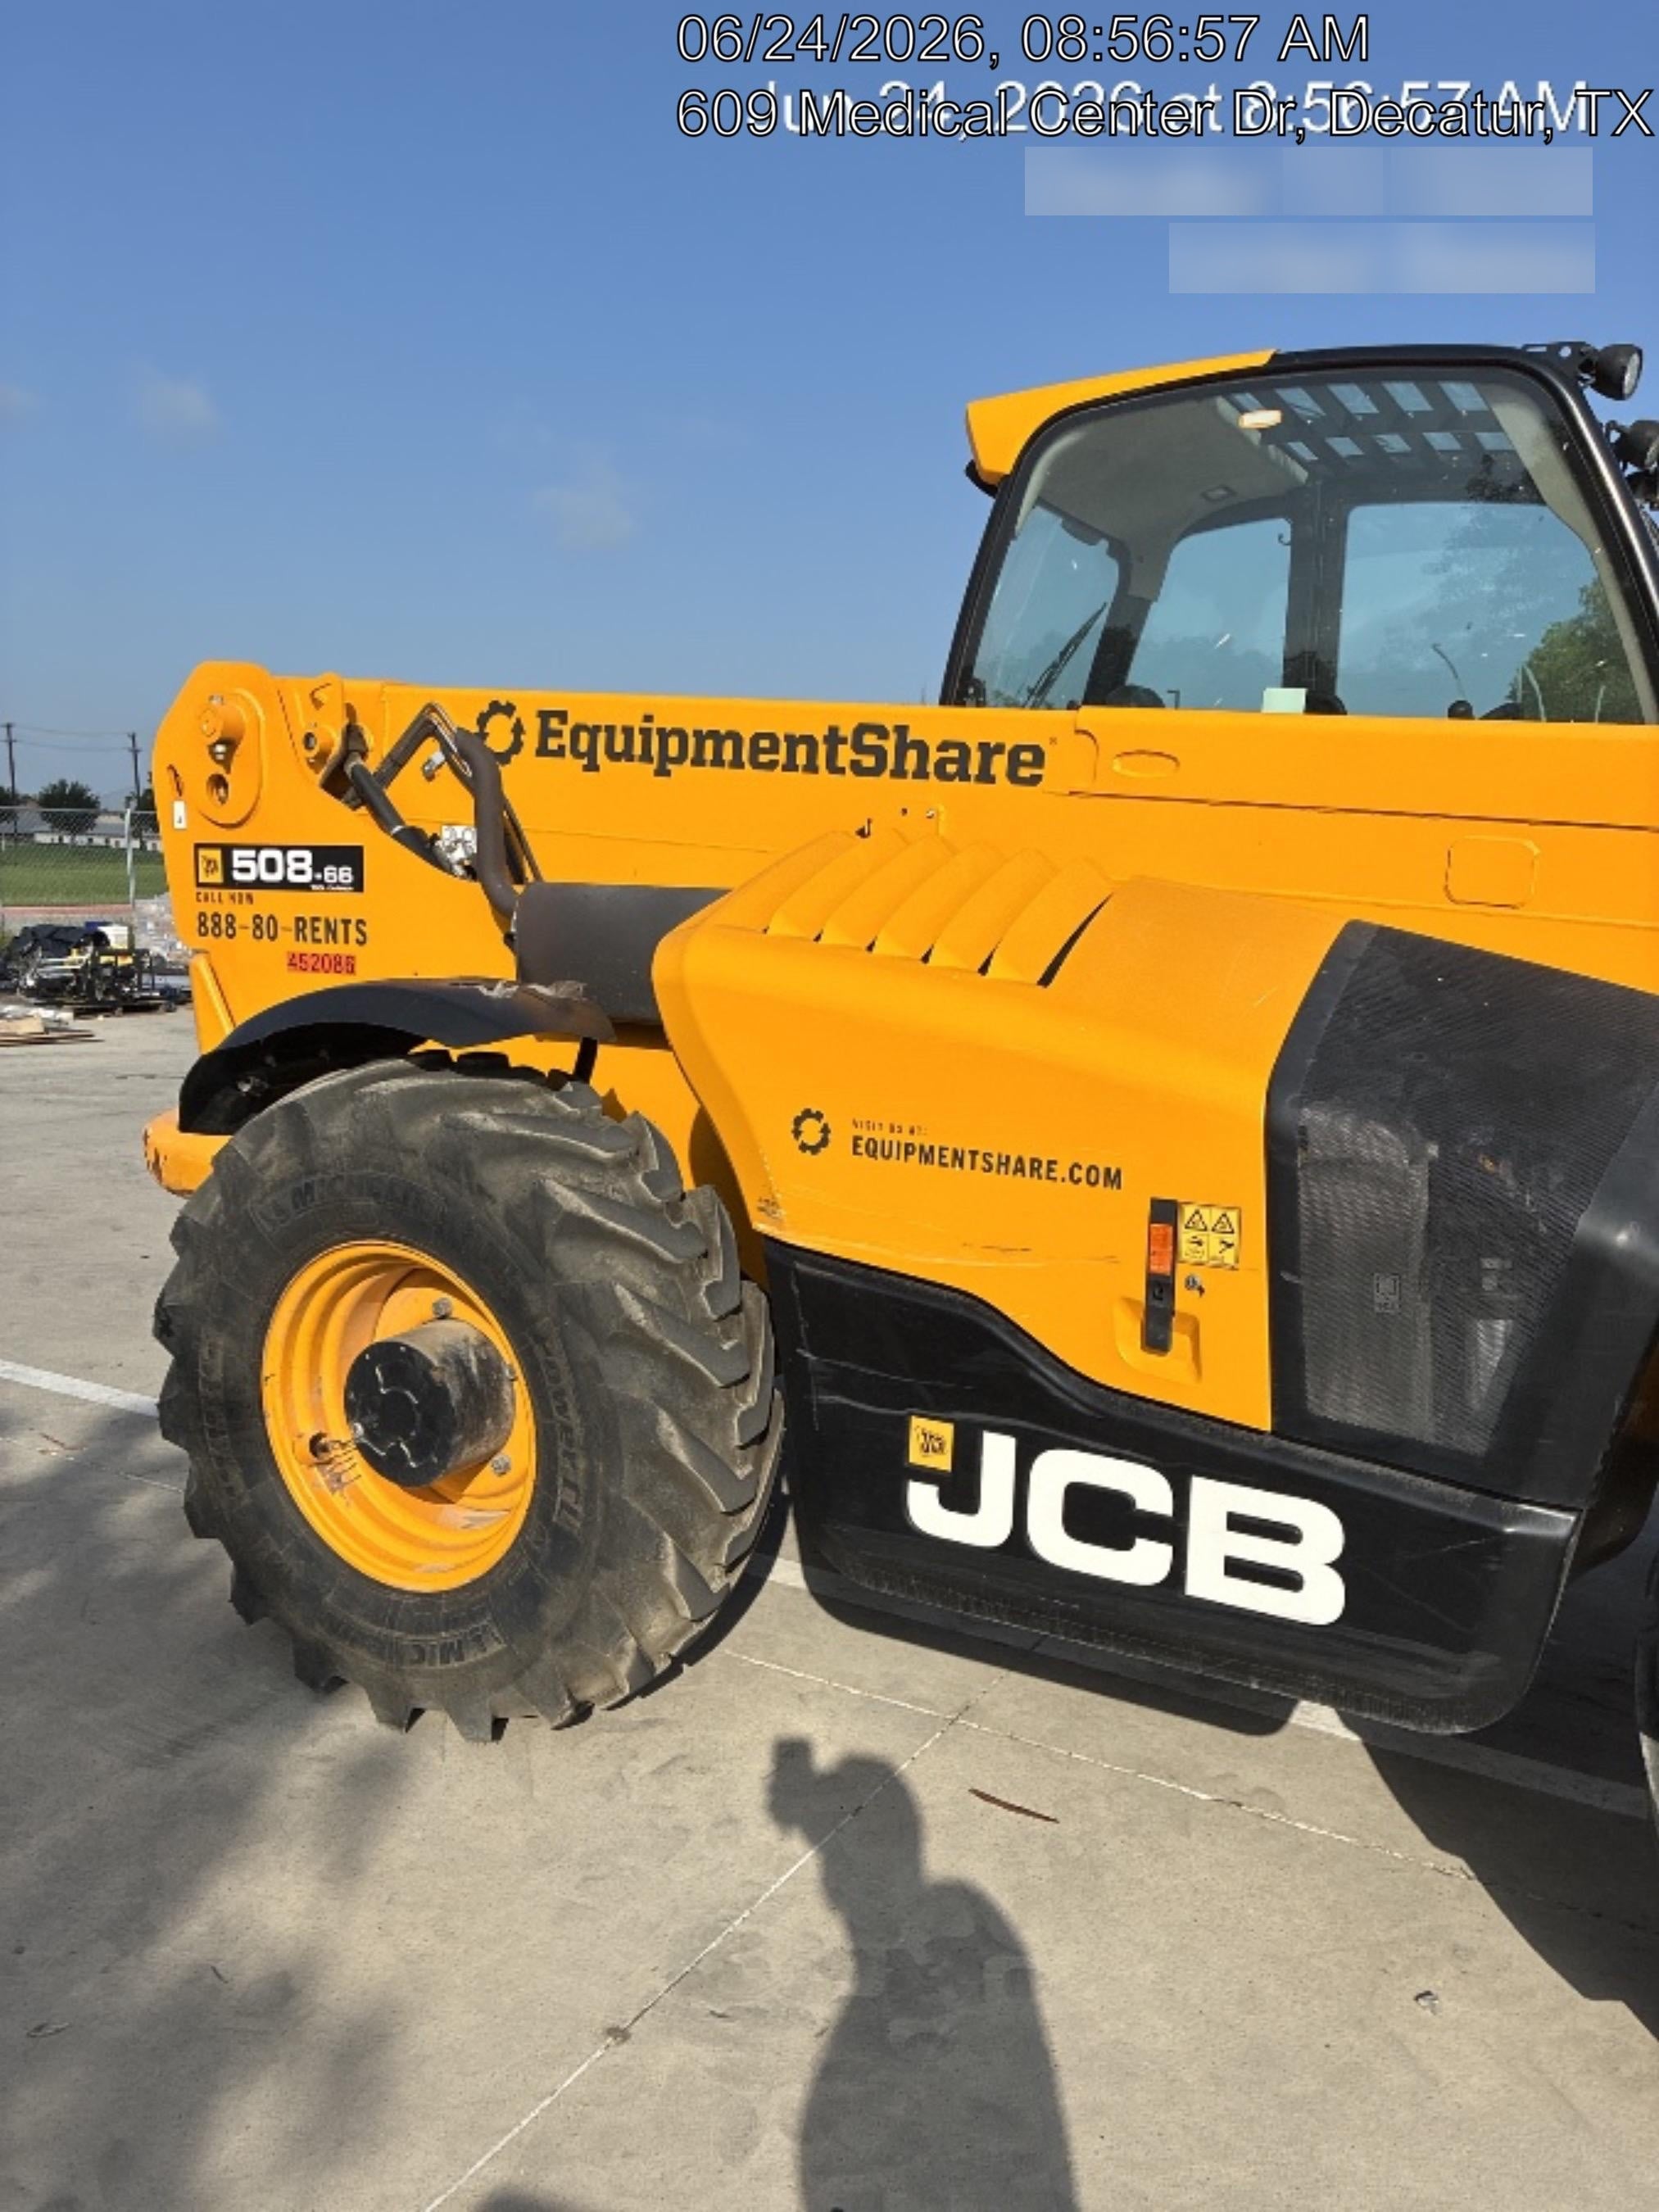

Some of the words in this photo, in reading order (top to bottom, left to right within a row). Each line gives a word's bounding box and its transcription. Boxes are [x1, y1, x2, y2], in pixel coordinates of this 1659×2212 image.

[535, 709, 1045, 786] EquipmentShare
[197, 911, 368, 946] 888-80-RENTS
[851, 1135, 1122, 1190] EQUIPMENTSHARE.COM
[906, 1430, 1346, 1626] JCB
